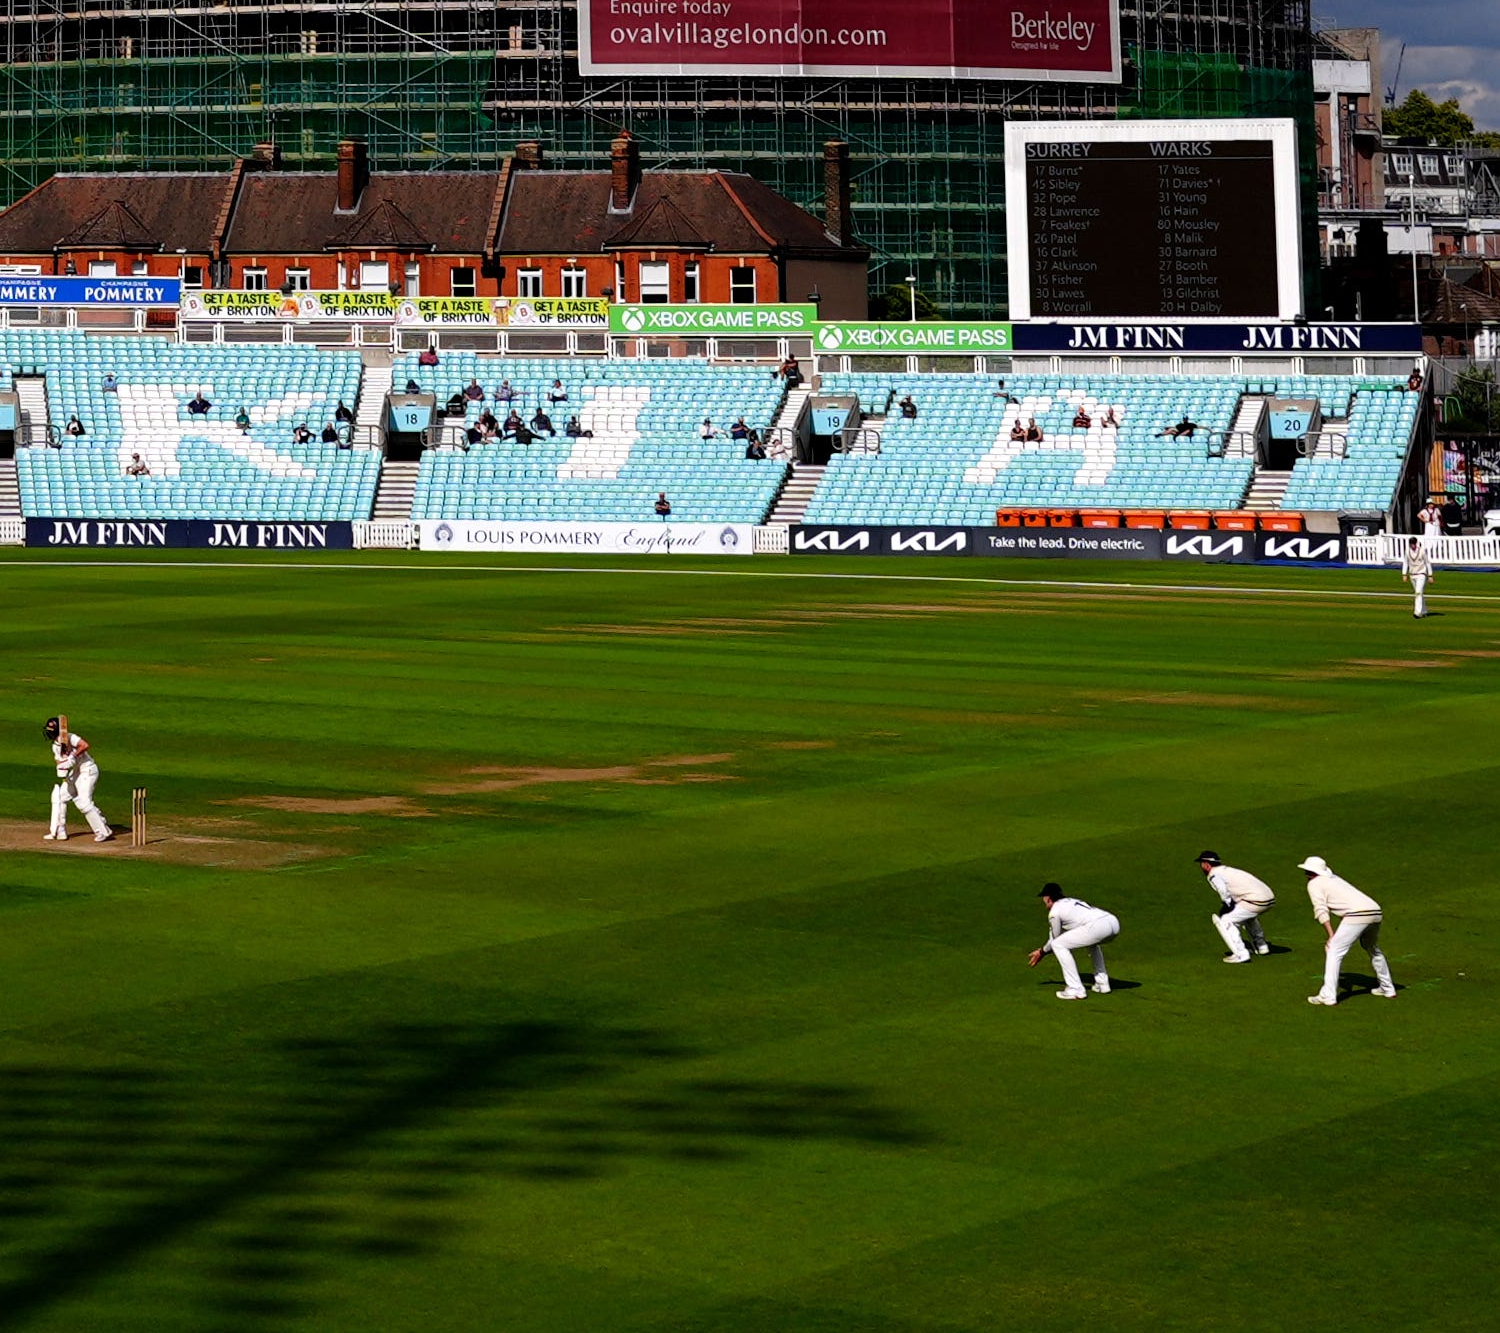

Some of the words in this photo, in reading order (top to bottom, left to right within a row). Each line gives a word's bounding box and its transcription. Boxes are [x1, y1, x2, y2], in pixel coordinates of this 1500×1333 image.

[610, 0, 677, 18] Enquire
[683, 0, 731, 18] today
[610, 22, 887, 50] ovalvillagelondon.com
[1011, 11, 1095, 51] Berkeley
[1027, 143, 1092, 158] SURREY
[1150, 142, 1212, 156] WARKS
[1050, 193, 1077, 205] Pope
[1173, 192, 1207, 204] Young
[1051, 247, 1078, 257] Clark
[1175, 246, 1217, 257] Barnard
[1052, 260, 1097, 271] Atkinson
[1176, 260, 1208, 271] Booth
[204, 294, 222, 305] GET
[226, 294, 236, 305] A
[238, 293, 270, 305] TASTE
[209, 306, 224, 317] OF
[227, 305, 276, 317] BRIXTON
[648, 312, 698, 327] XBOX
[699, 312, 753, 327] GAME
[757, 311, 804, 326] PASS
[1069, 326, 1108, 348] JM
[1115, 326, 1185, 348] FINN
[404, 413, 418, 426] 18
[827, 416, 841, 429] 19
[1284, 419, 1301, 432] 20
[49, 522, 88, 544] JM
[98, 523, 168, 545] FINN
[467, 530, 517, 545] LOUIS
[519, 530, 603, 545] POMMERY
